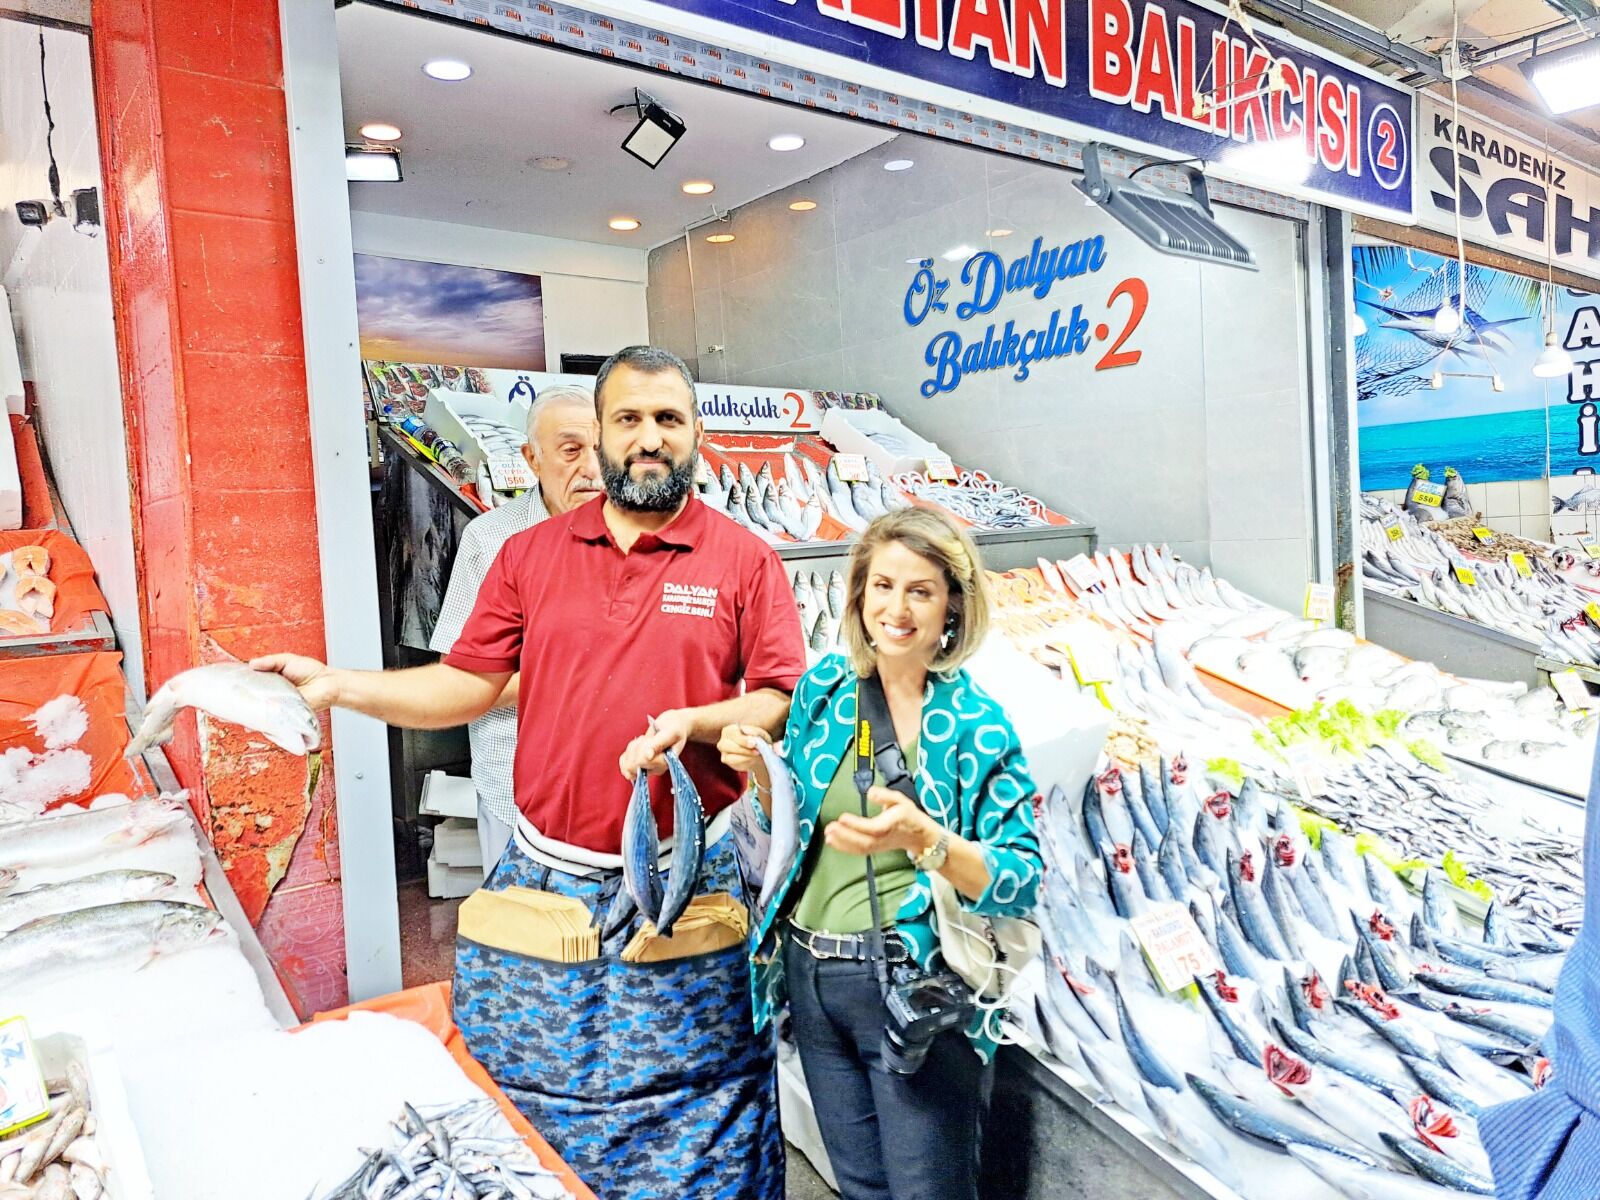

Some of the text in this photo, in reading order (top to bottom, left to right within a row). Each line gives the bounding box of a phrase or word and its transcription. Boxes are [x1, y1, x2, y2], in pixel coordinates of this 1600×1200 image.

[1376, 120, 1397, 171] 2
[1434, 113, 1566, 190] KARADENİZ
[903, 234, 1107, 327] Öz Dalyan
[920, 304, 1091, 398] Balıkçılık
[698, 394, 781, 425] alıkçılık
[1418, 494, 1434, 503] 550
[663, 582, 718, 598] DALYAN
[1177, 952, 1201, 975] 75
